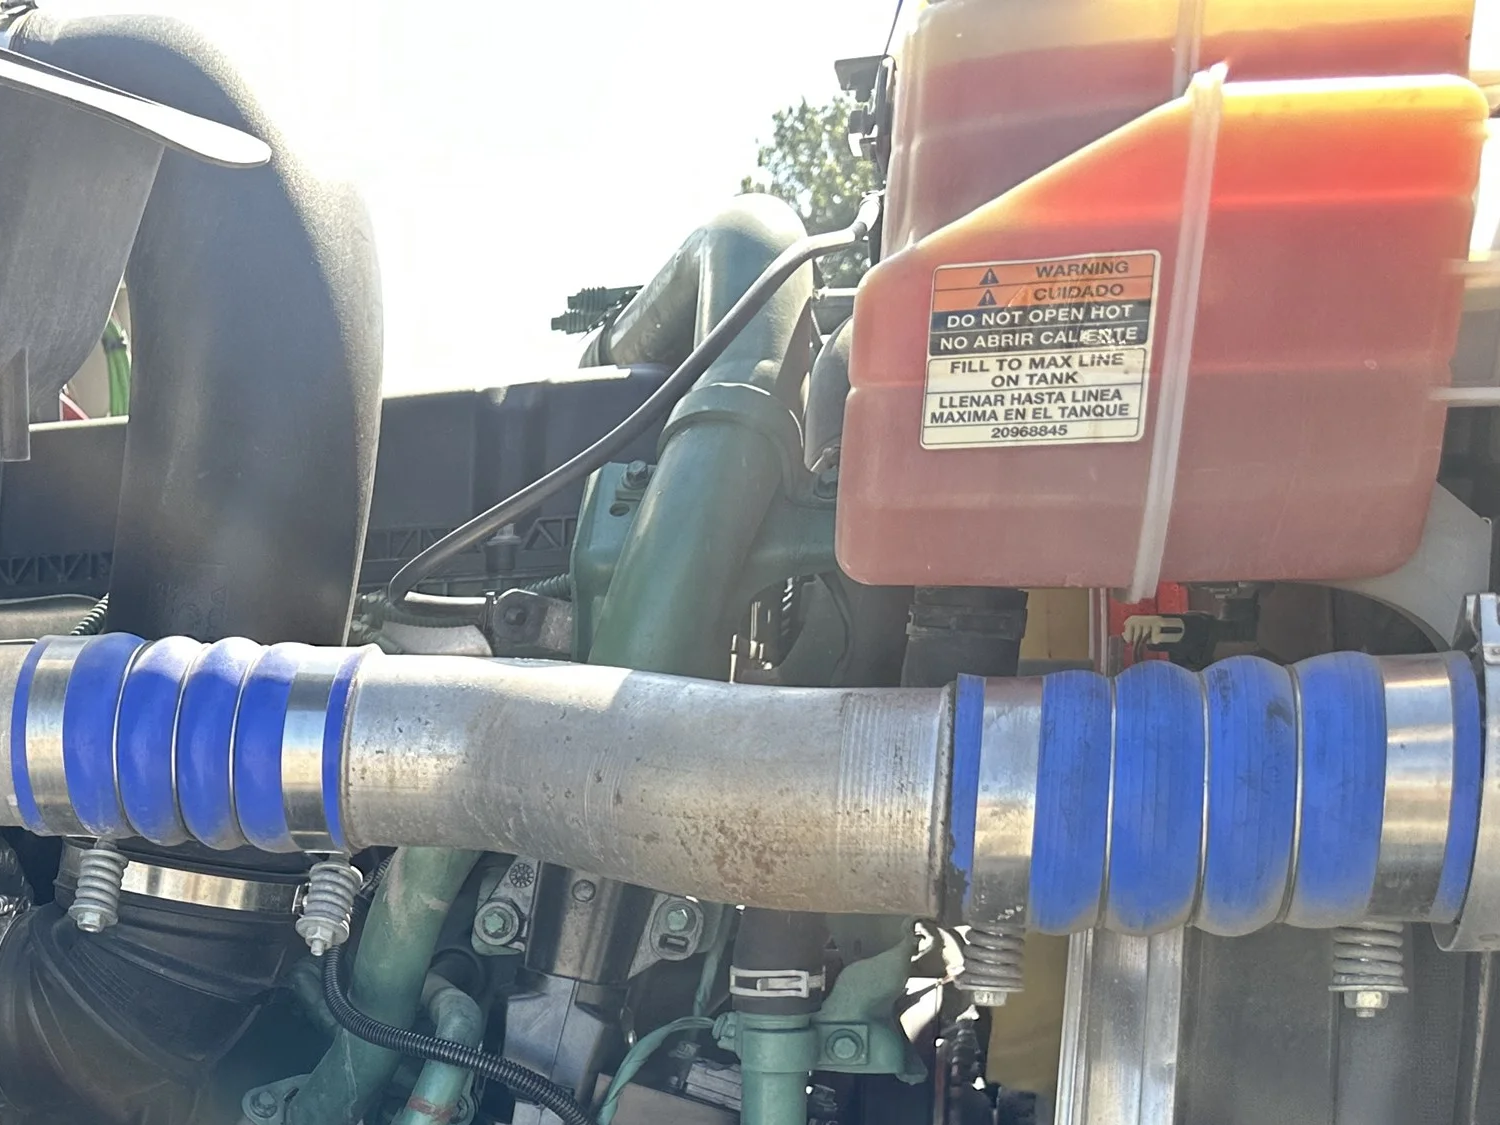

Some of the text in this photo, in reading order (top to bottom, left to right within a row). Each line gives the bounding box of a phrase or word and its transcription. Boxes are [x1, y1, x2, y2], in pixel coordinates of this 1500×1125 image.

[1036, 260, 1129, 279] WARNING
[1033, 283, 1125, 302] CUIDADO
[947, 304, 1134, 328] DO NOT OPEN HOT
[940, 327, 1138, 350] NO ABRIR CALIENTE
[950, 352, 1125, 374] FILL TO MAX LINE
[991, 371, 1079, 388] ON TANK
[939, 388, 1123, 409] LLENAR HASTA LINEA
[930, 403, 1130, 424] MAXIMA EN EL TANQUE
[990, 424, 1068, 440] 20968845
